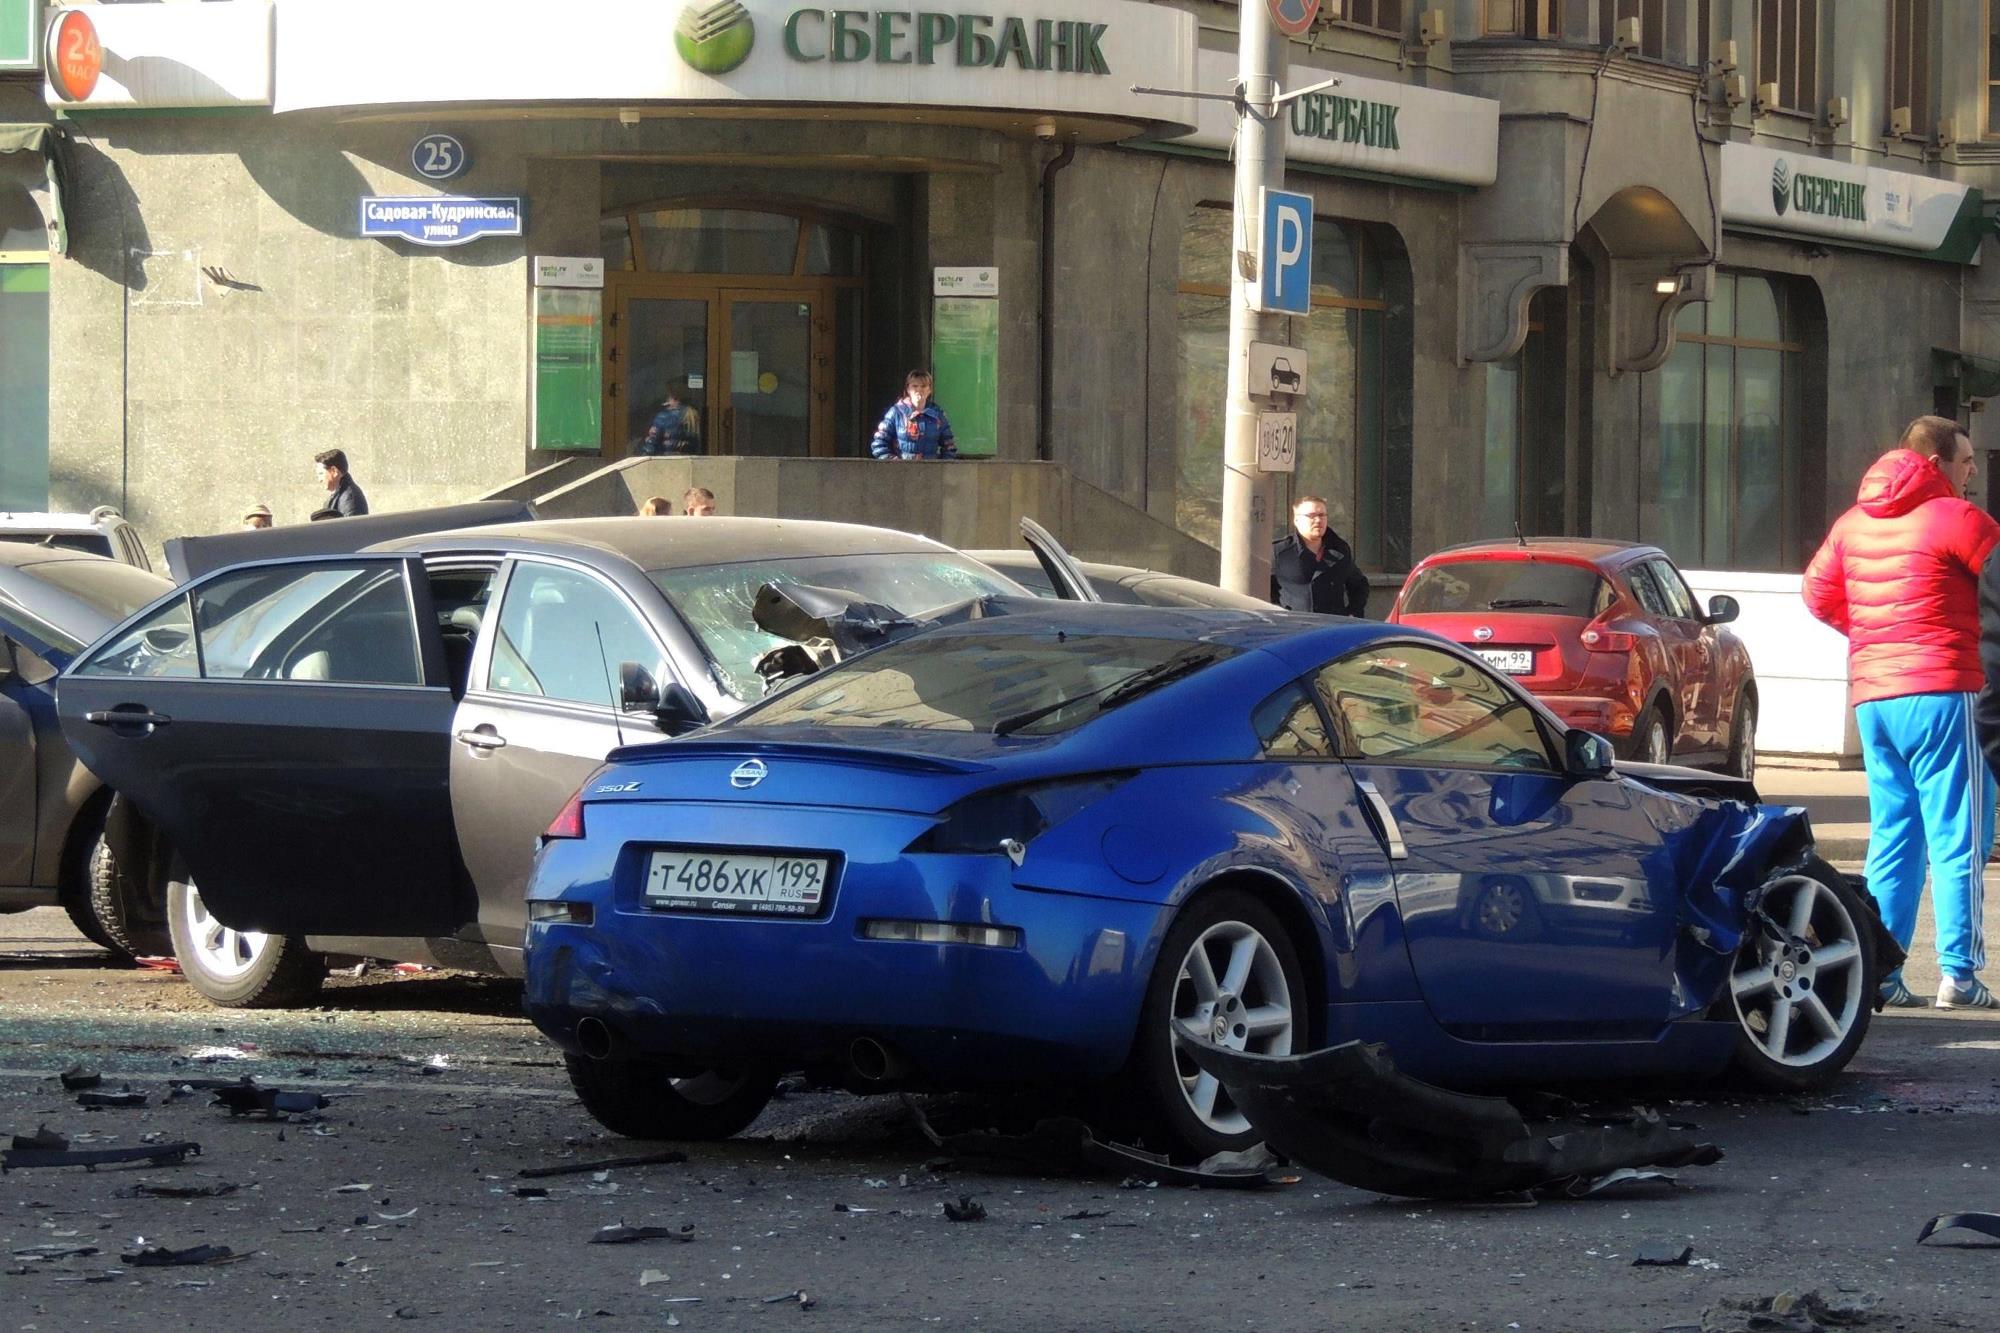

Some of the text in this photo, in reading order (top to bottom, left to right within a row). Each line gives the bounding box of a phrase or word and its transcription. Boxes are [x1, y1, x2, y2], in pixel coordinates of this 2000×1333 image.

[67, 28, 100, 64] 24
[783, 8, 1111, 75] СБЕРБАНК
[1288, 92, 1400, 150] СБЕРБАНК
[423, 142, 452, 171] 25
[1793, 172, 1867, 221] СБЕРБАНК
[367, 203, 515, 222] Садовая-Кудринская
[423, 224, 459, 238] улица
[1275, 205, 1303, 297] P
[1271, 428, 1279, 451] 15
[1281, 425, 1293, 454] 20
[1511, 653, 1526, 664] 99
[595, 781, 641, 793] 350Z
[660, 859, 819, 895] Т486ХК 199
[780, 889, 801, 899] RUS
